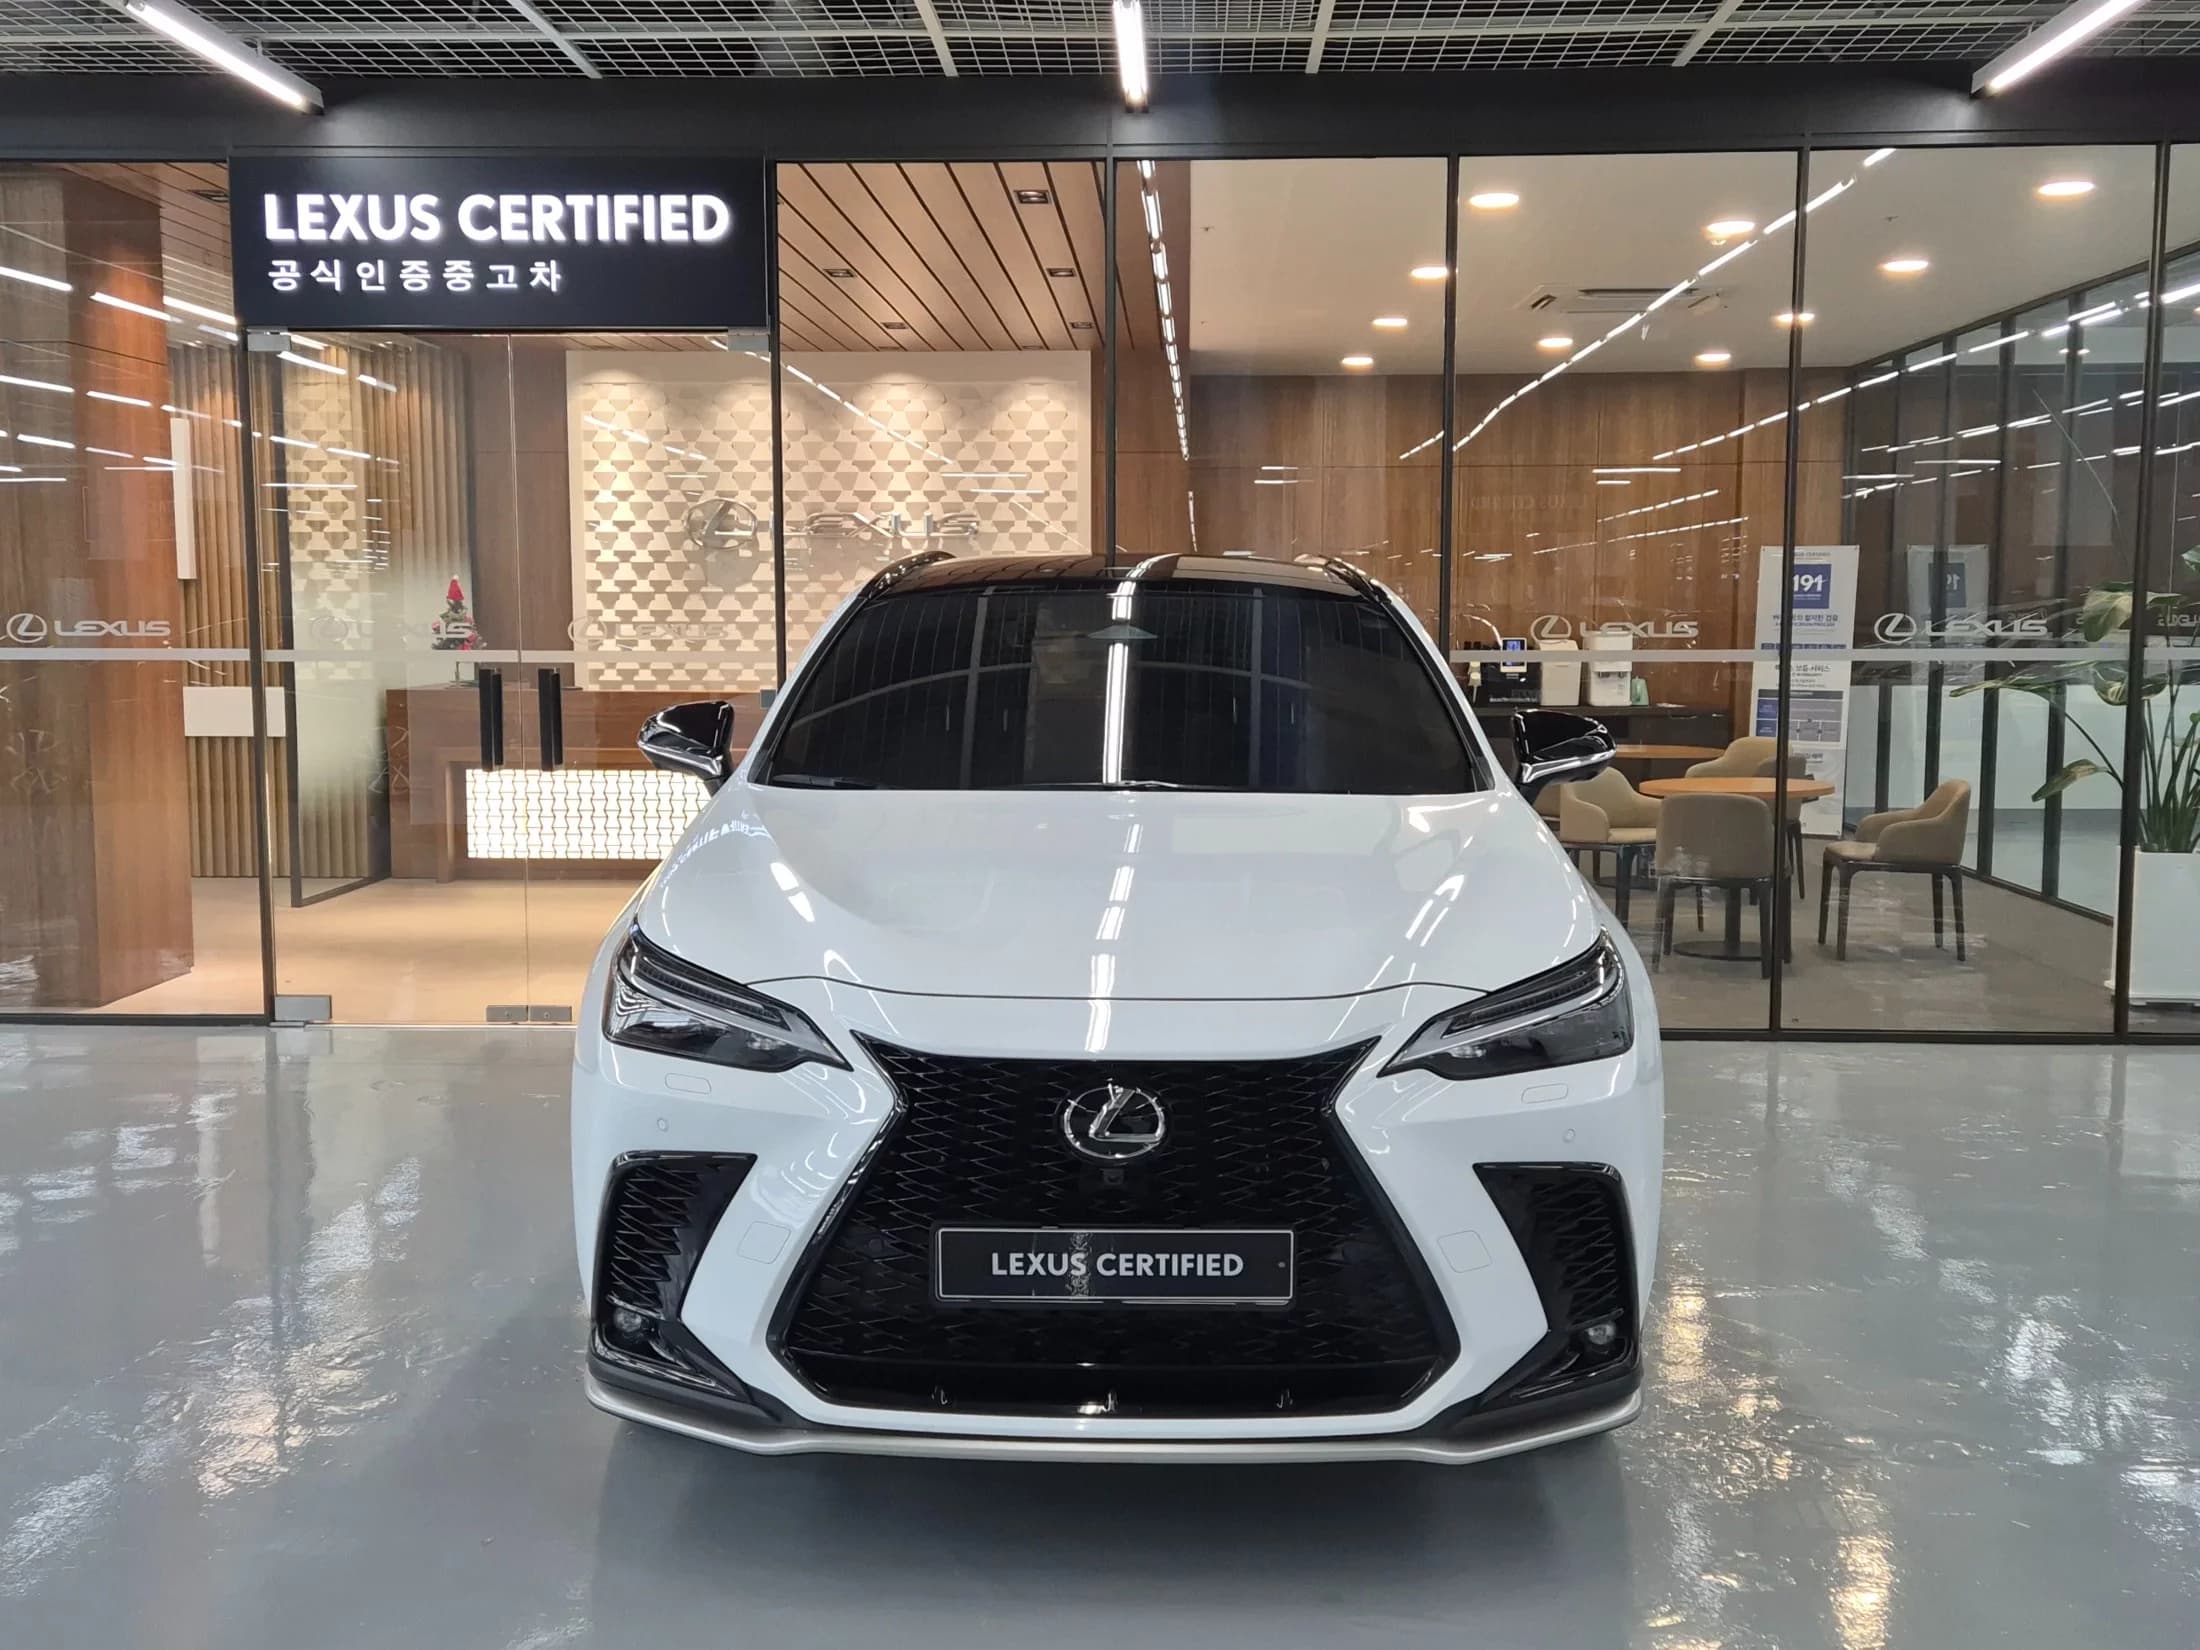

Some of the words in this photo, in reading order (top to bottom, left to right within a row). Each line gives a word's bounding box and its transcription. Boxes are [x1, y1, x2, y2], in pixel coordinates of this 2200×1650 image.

[263, 193, 441, 242] LEXUS
[458, 193, 731, 242] CERTIFIED
[1793, 574, 1824, 592] 191
[55, 620, 171, 636] LEXUS
[1580, 621, 1699, 638] LEXUS
[1925, 619, 2048, 637] LEXUS
[992, 1253, 1087, 1276] LEXUS
[1097, 1253, 1244, 1276] CERTIFIED
